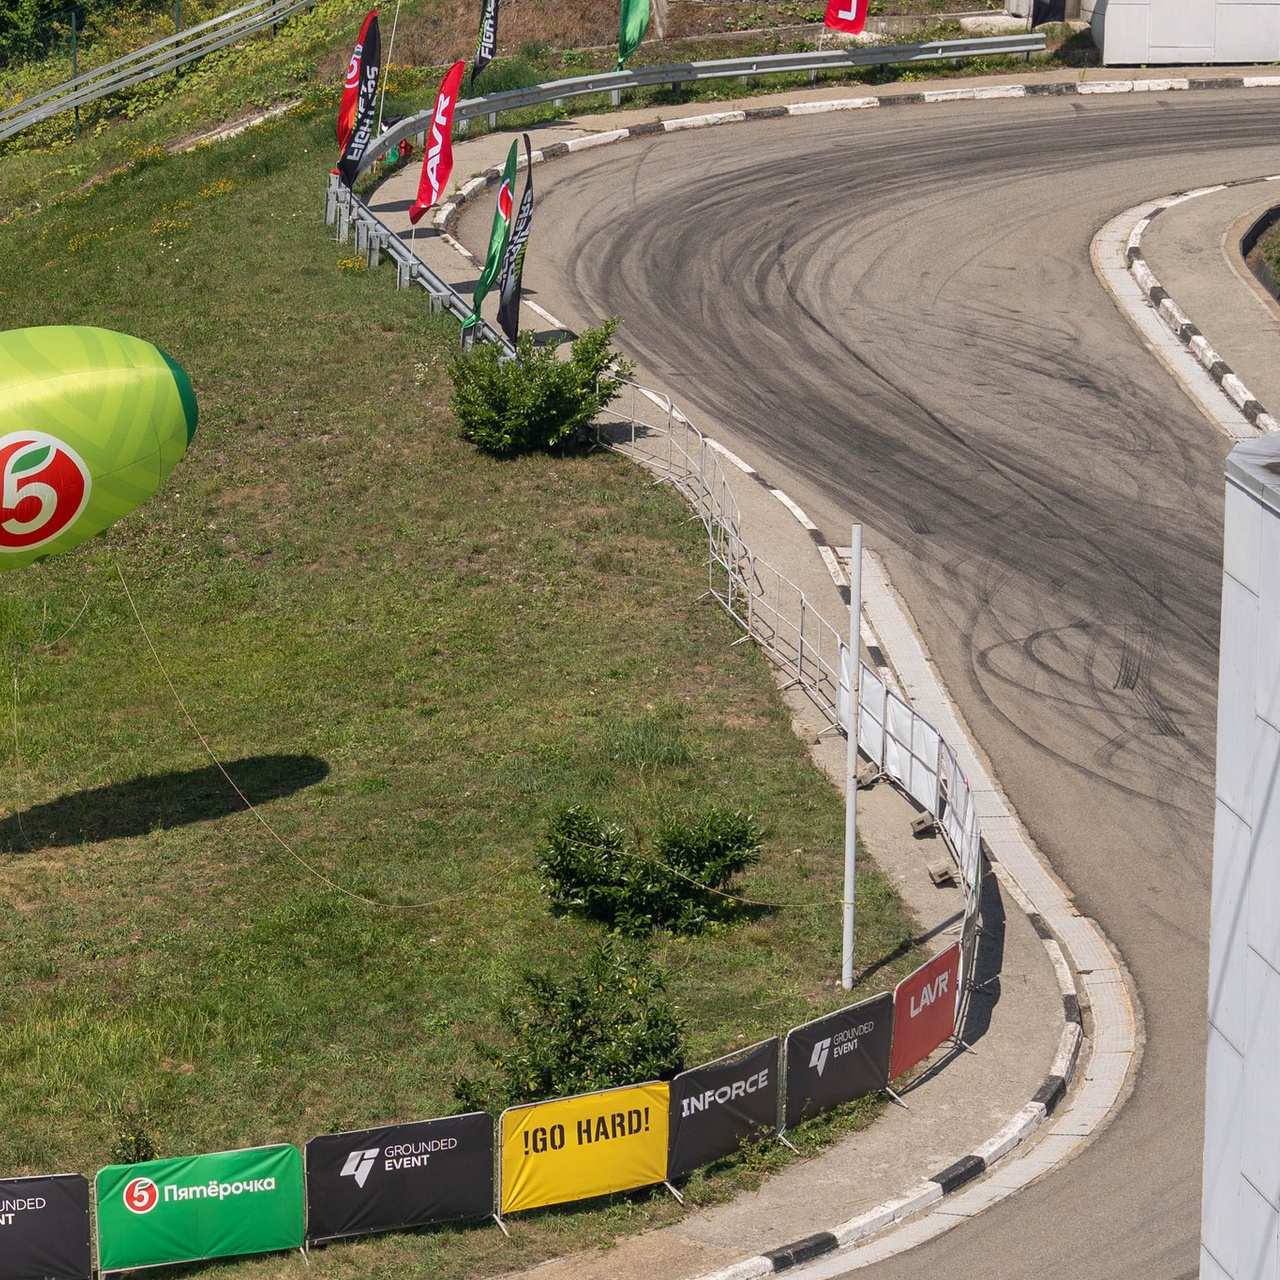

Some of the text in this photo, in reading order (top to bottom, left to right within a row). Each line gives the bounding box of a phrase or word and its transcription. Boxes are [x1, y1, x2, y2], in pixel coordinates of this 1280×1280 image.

[910, 972, 948, 1018] LAVR
[833, 1021, 875, 1044] GROUNDED
[833, 1040, 858, 1058] EVENT
[681, 1068, 769, 1117] INFORCE
[523, 1107, 650, 1155] !GO HARD!
[384, 1138, 457, 1157] GROUNDED
[385, 1154, 430, 1170] EVENT
[164, 1177, 276, 1201] Пятёрочка
